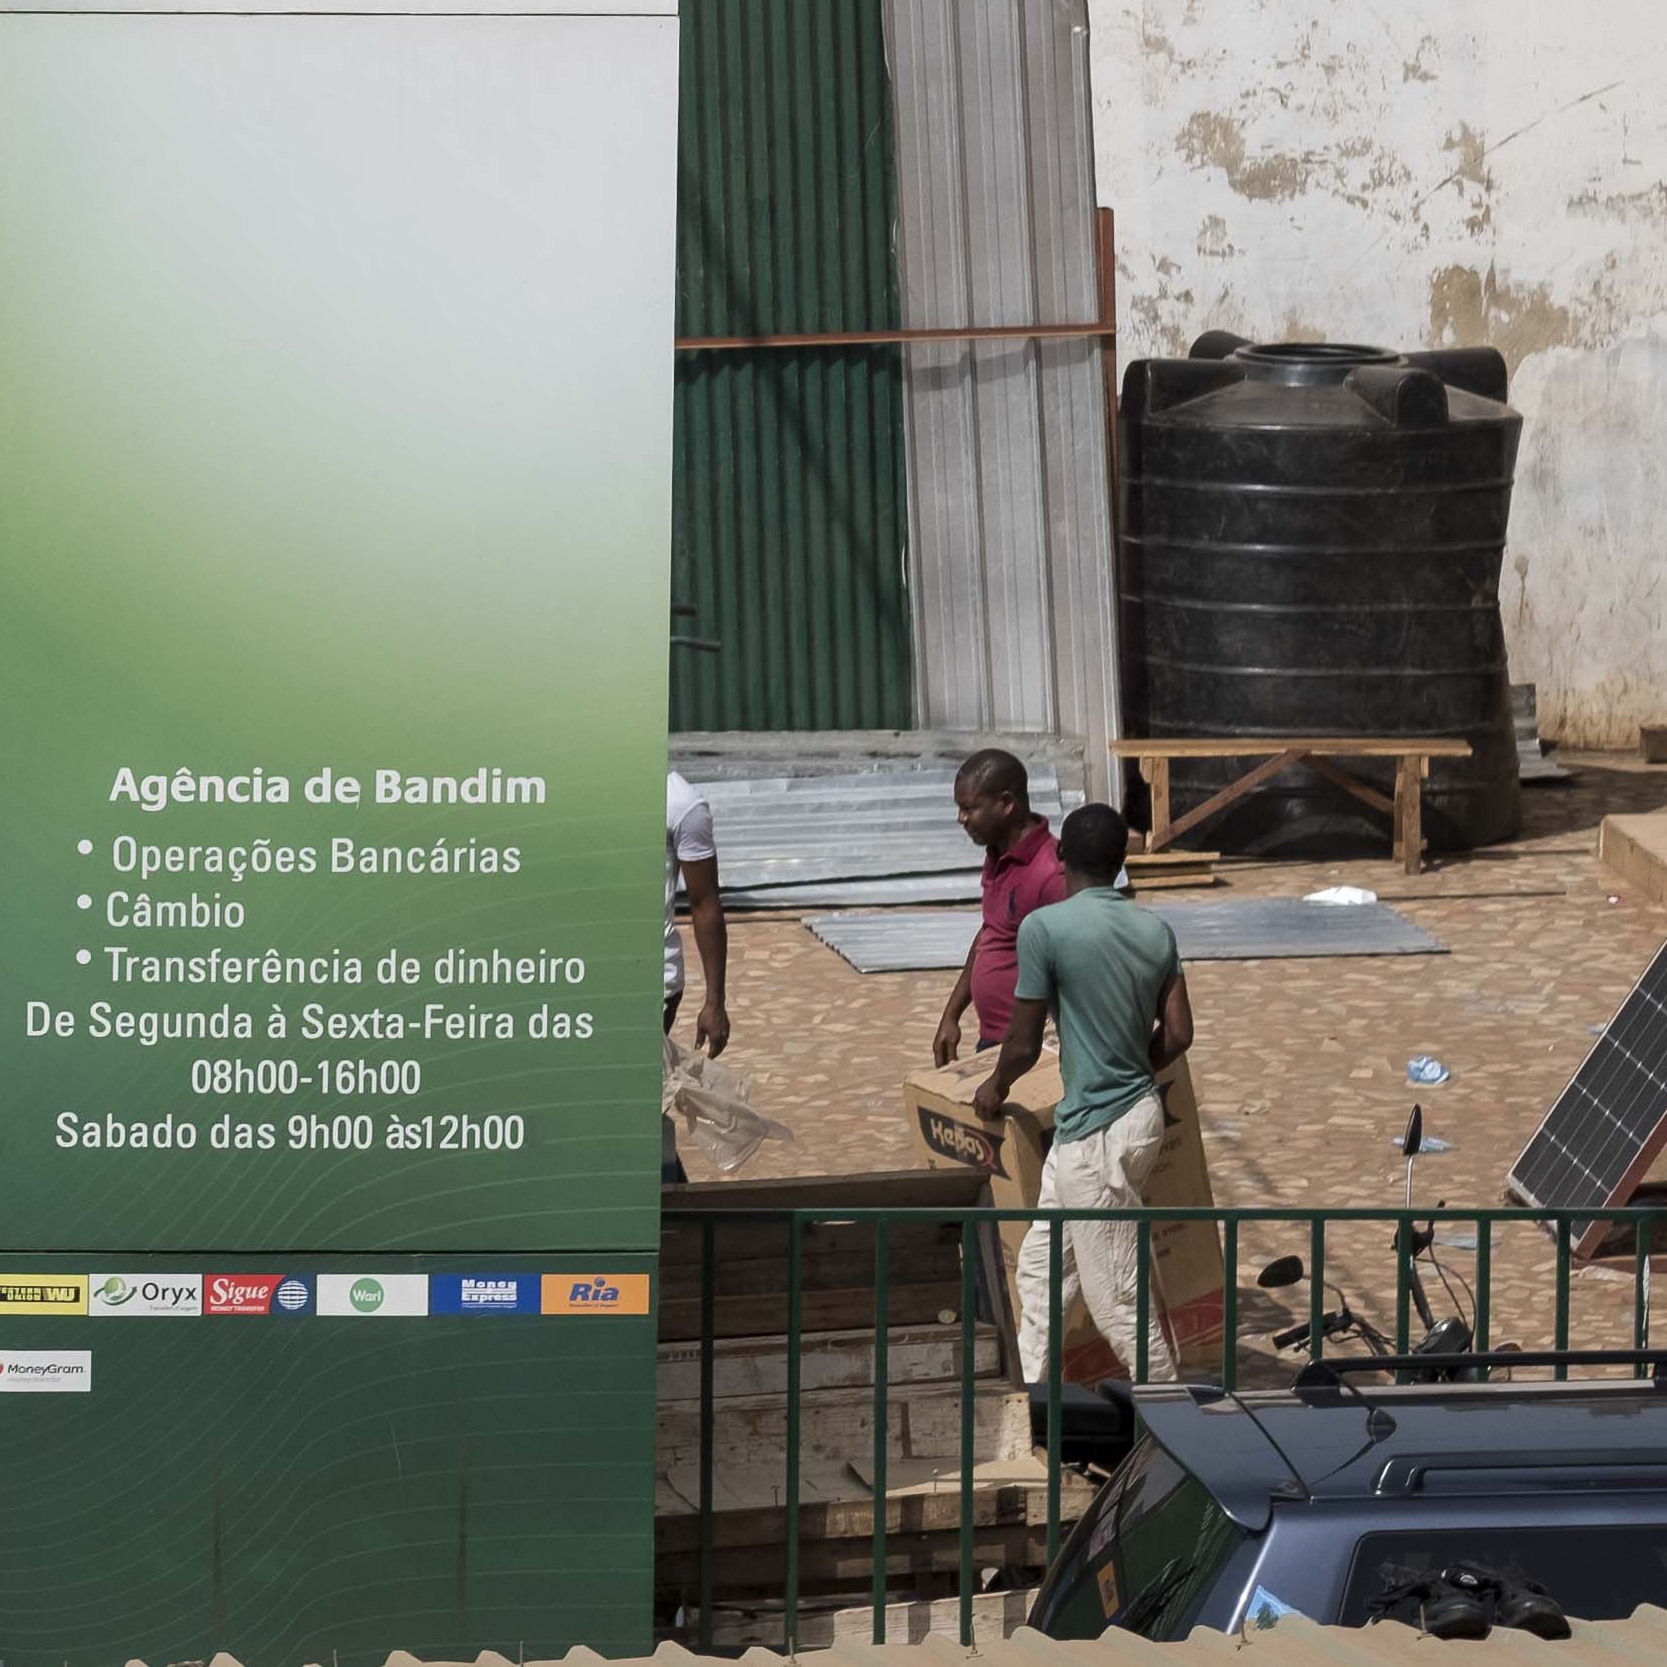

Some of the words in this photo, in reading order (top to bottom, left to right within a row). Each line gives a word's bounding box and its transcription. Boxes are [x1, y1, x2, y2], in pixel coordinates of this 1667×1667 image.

[110, 767, 290, 811] Agência
[305, 768, 360, 804] de
[375, 768, 546, 804] Bandim
[113, 836, 317, 882] Operações
[331, 837, 521, 873] Bancárias
[107, 891, 245, 928] Câmbio
[105, 947, 362, 984] Transferência
[377, 948, 421, 984] de
[434, 948, 585, 984] dinheiro
[27, 1001, 74, 1037] De
[89, 1002, 252, 1046] Segunda
[268, 1004, 286, 1038] à
[302, 1003, 514, 1039] Sexta-Feira
[529, 1004, 593, 1039] das
[191, 1059, 421, 1095] 08h00-16h00
[56, 1112, 197, 1149] Sabado
[210, 1114, 276, 1149] das
[288, 1114, 373, 1150] 9h00
[7, 1293, 40, 1301] UNION
[142, 1282, 197, 1309] Oryx
[209, 1278, 268, 1306] Sigue
[353, 1289, 382, 1302] Wari
[461, 1279, 517, 1290] Money
[461, 1291, 517, 1303] Express
[569, 1277, 619, 1302] Ria
[7, 1363, 83, 1376] MoneyGram
